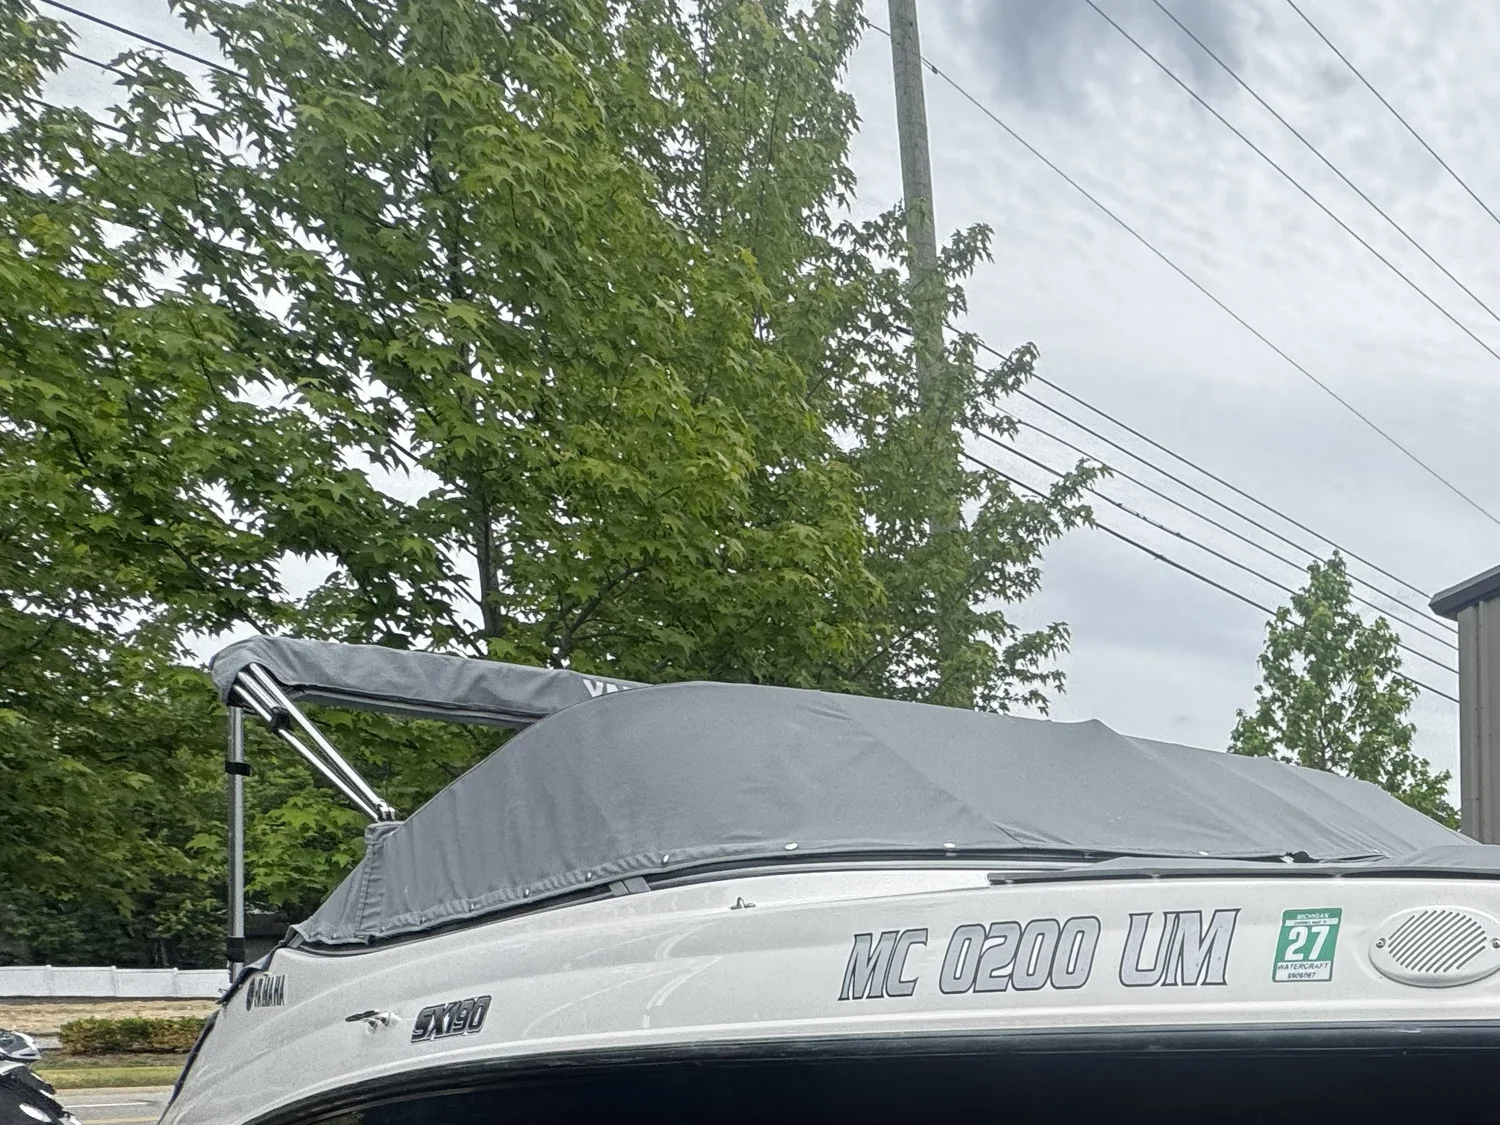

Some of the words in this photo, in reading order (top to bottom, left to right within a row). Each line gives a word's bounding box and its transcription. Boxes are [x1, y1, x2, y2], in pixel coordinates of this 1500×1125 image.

[838, 930, 927, 1001] MC
[938, 916, 1102, 995] 0200
[1119, 908, 1241, 988] UM
[1284, 926, 1330, 960] 27
[411, 995, 492, 1043] SX190
